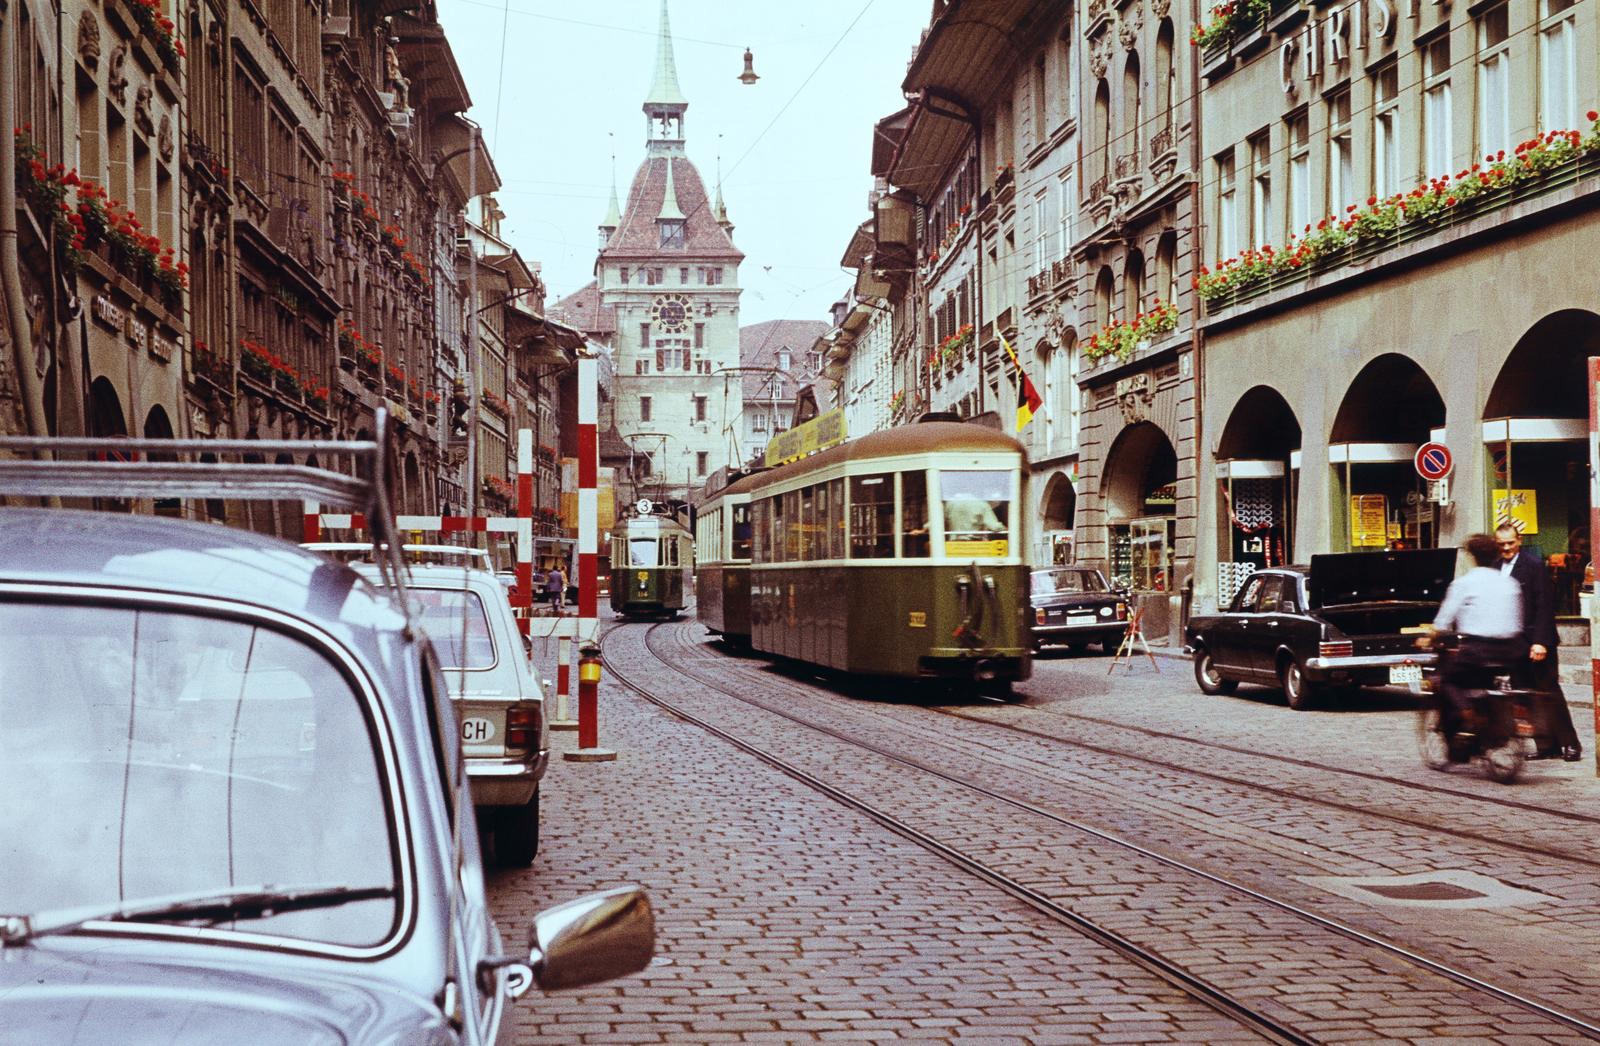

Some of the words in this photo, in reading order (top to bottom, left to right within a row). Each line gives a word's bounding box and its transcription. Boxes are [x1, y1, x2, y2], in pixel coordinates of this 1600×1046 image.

[1280, 0, 1417, 93] CHRIS
[640, 500, 649, 512] 3
[462, 721, 487, 740] CH
